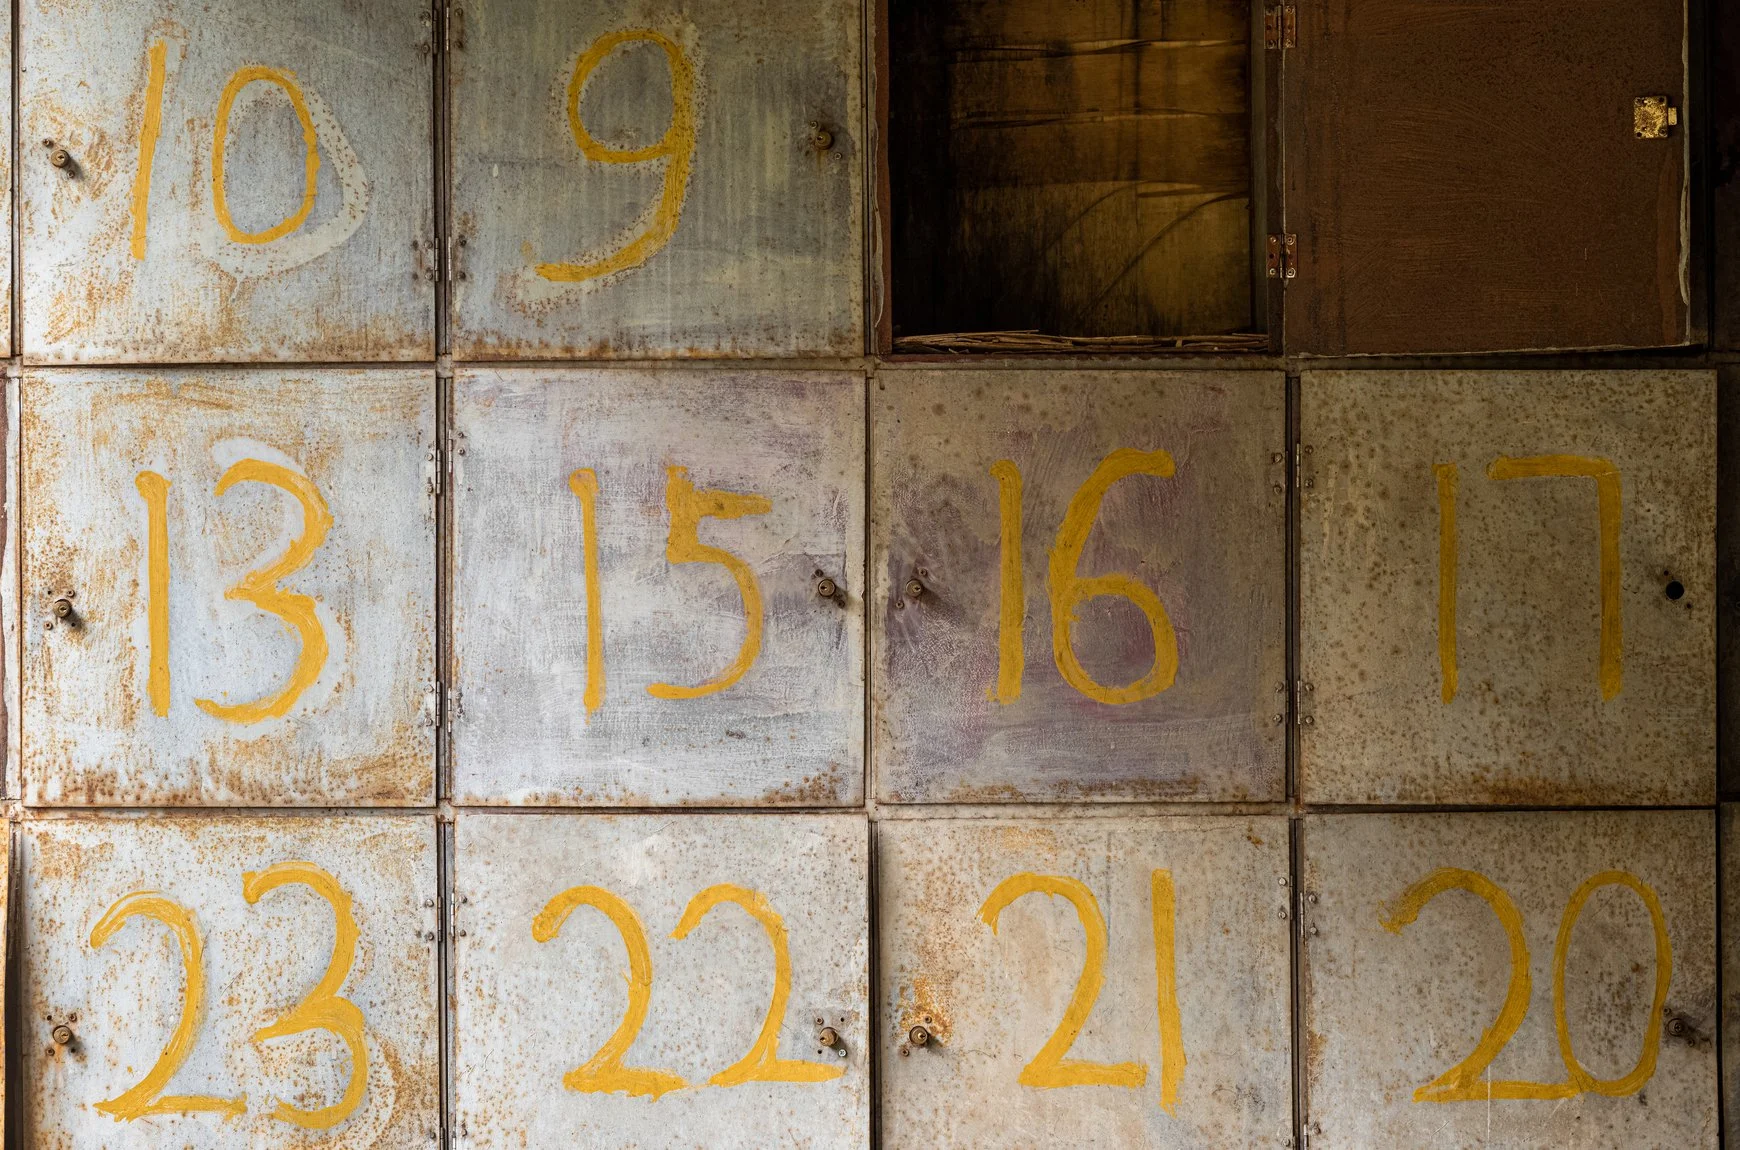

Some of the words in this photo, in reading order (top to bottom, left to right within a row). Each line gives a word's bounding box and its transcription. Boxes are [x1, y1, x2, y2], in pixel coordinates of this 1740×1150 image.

[131, 38, 321, 261] 10
[535, 28, 698, 283] 9
[136, 459, 334, 724] 13
[570, 466, 772, 719] 15
[988, 448, 1179, 707] 16
[1434, 454, 1623, 704] 17
[91, 861, 368, 1130] 23
[533, 884, 845, 1102] 22
[978, 870, 1188, 1114] 21
[1380, 867, 1673, 1103] 20
